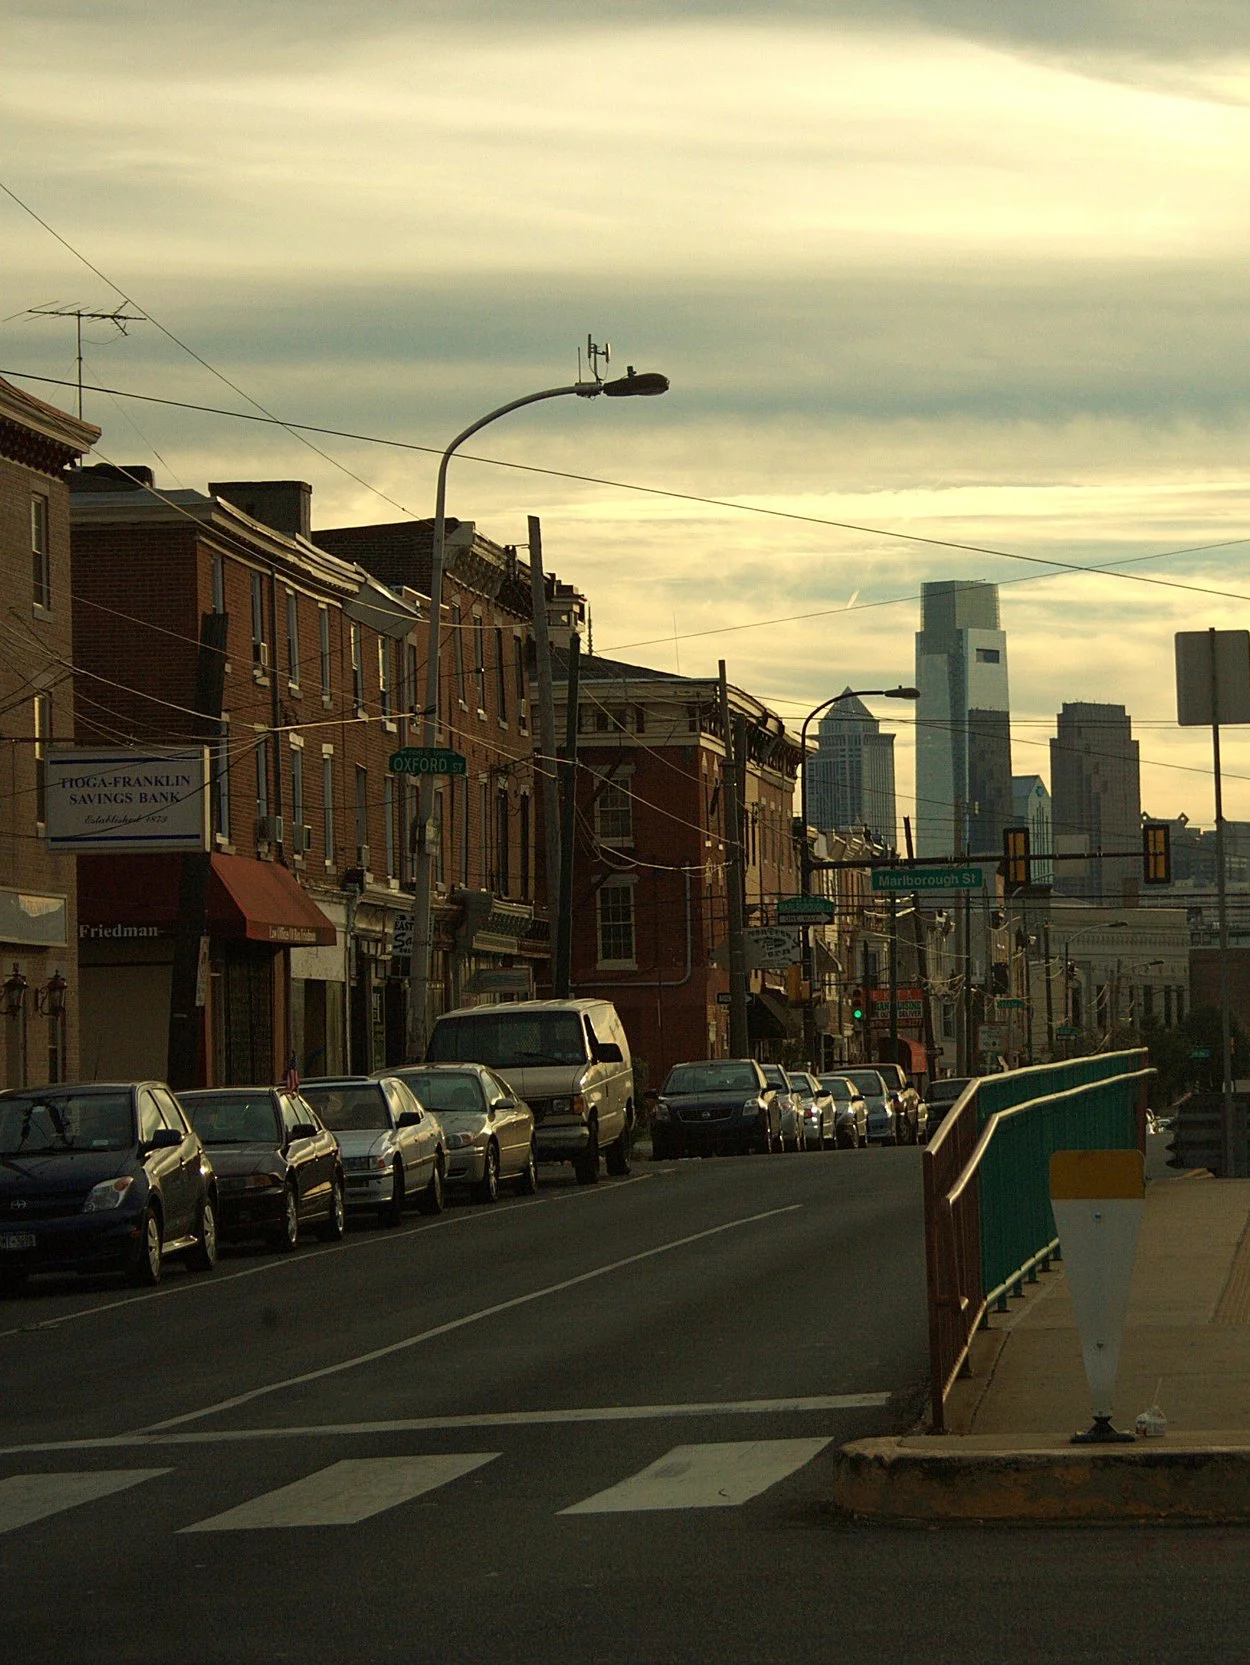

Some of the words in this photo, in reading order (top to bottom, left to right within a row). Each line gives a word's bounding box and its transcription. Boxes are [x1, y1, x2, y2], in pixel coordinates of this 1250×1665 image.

[394, 758, 447, 772] OXFORD
[452, 762, 465, 772] ST
[60, 775, 191, 789] TIOGA-FRANKLIN
[69, 792, 133, 805] SAVINGS
[139, 791, 181, 804] BANK
[84, 814, 142, 825] Established
[879, 873, 960, 888] Marlborough
[962, 872, 976, 885] St
[79, 924, 159, 938] Friedman
